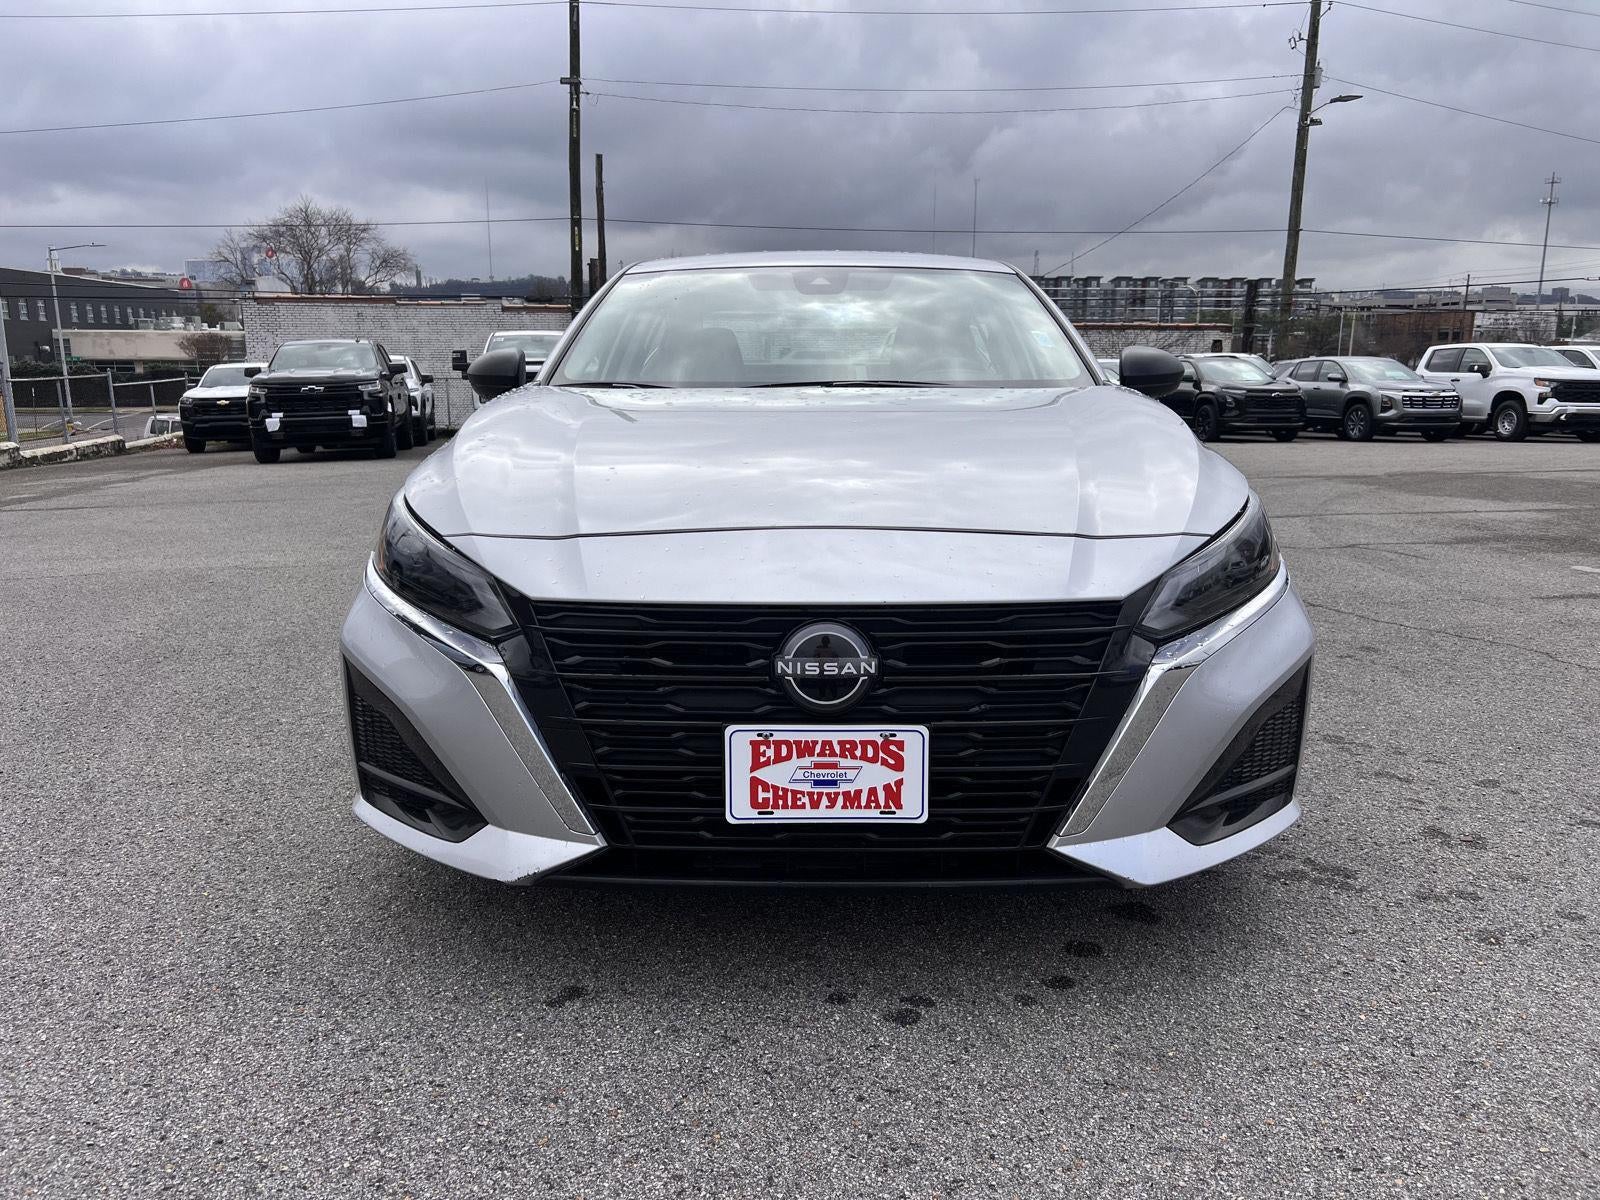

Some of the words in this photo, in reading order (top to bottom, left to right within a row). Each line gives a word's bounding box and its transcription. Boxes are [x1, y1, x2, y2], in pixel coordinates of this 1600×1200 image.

[777, 661, 876, 675] NISSAN
[749, 739, 905, 773] EDWARDS
[802, 770, 848, 779] Chevrolet
